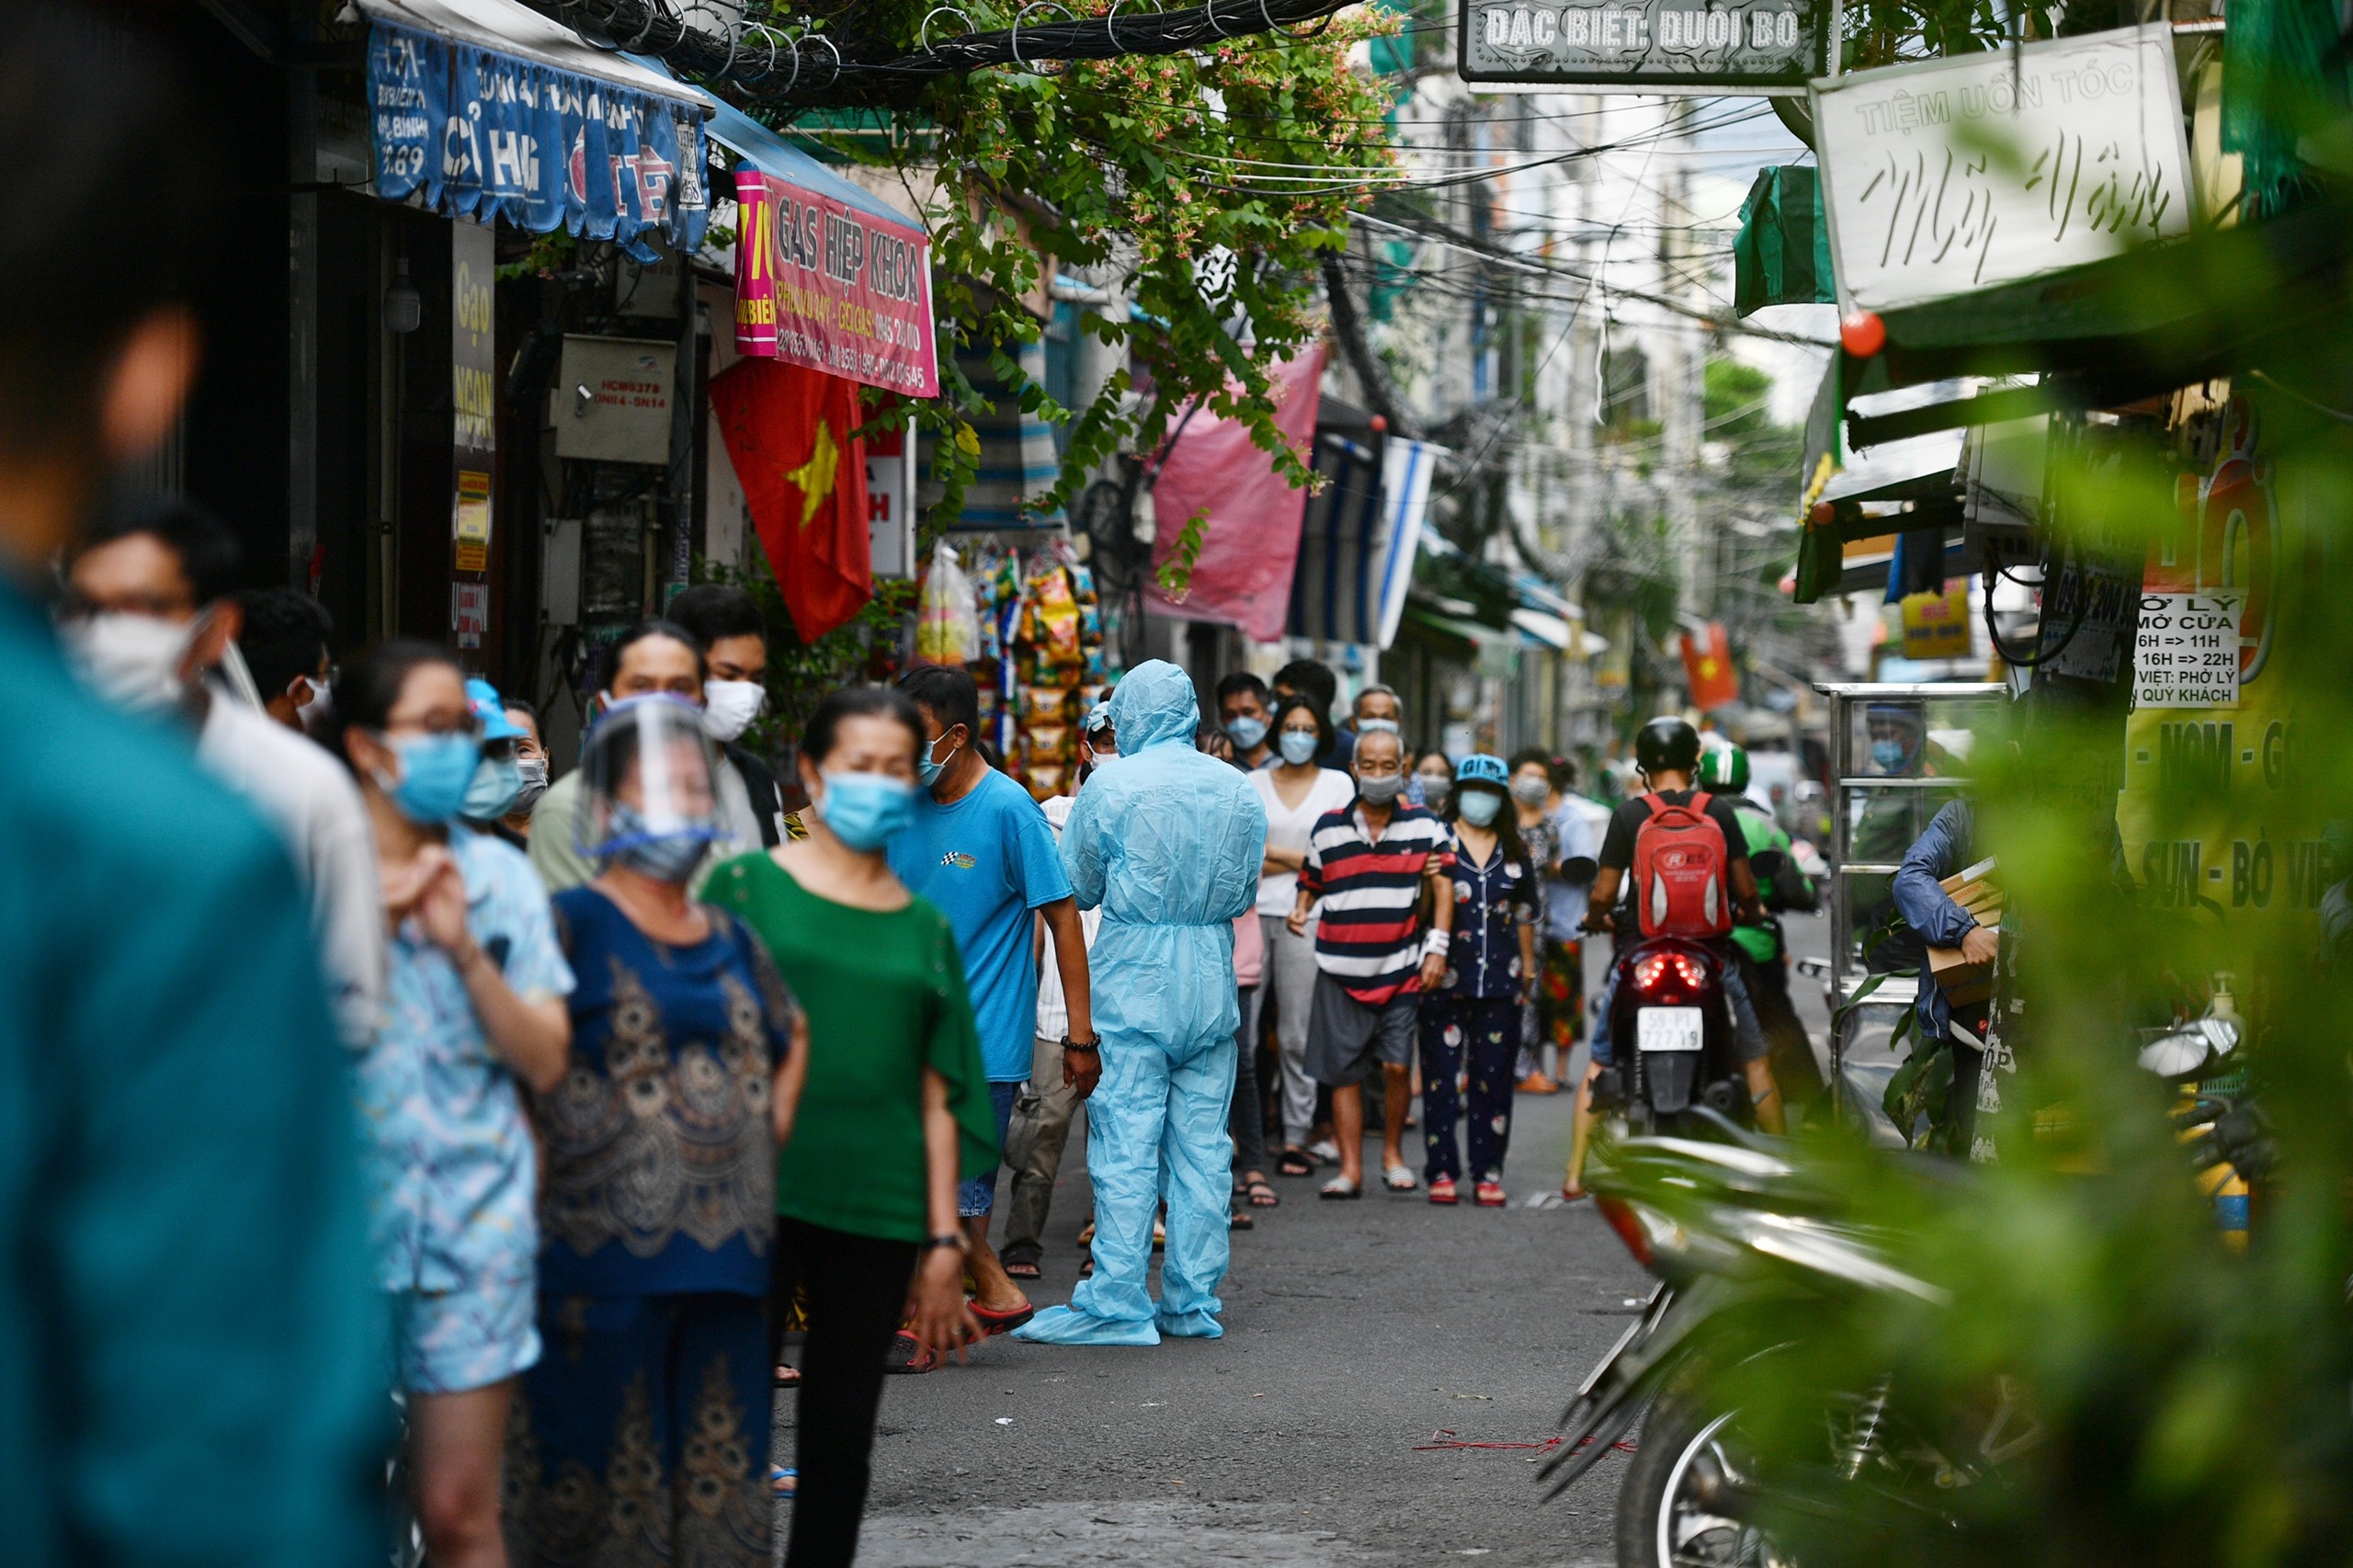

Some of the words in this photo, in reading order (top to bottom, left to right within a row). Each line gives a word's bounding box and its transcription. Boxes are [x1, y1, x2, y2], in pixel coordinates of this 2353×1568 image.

[1658, 2, 1741, 47] ĐUÔI
[1752, 2, 1798, 47] BÒ
[1856, 89, 1950, 136] TIỆM
[1961, 65, 2044, 120] UỐN
[2052, 59, 2133, 104] TÓC
[778, 196, 819, 272] GAS
[824, 206, 865, 297] HIỆP
[869, 228, 919, 306] KHOA
[456, 260, 490, 347] Gạo
[2187, 595, 2239, 611] LÝ
[2179, 613, 2234, 630] CỬA
[2138, 634, 2159, 647] 6H
[2190, 634, 2220, 647] 11H
[2143, 653, 2173, 665] 16H
[2203, 653, 2234, 665] 22H
[2139, 668, 2174, 687] VIỆT:
[2179, 668, 2213, 684] PHỞ
[2217, 668, 2234, 684] LÝ
[2143, 686, 2174, 702] QUÝ
[2179, 686, 2232, 702] KHÁCH
